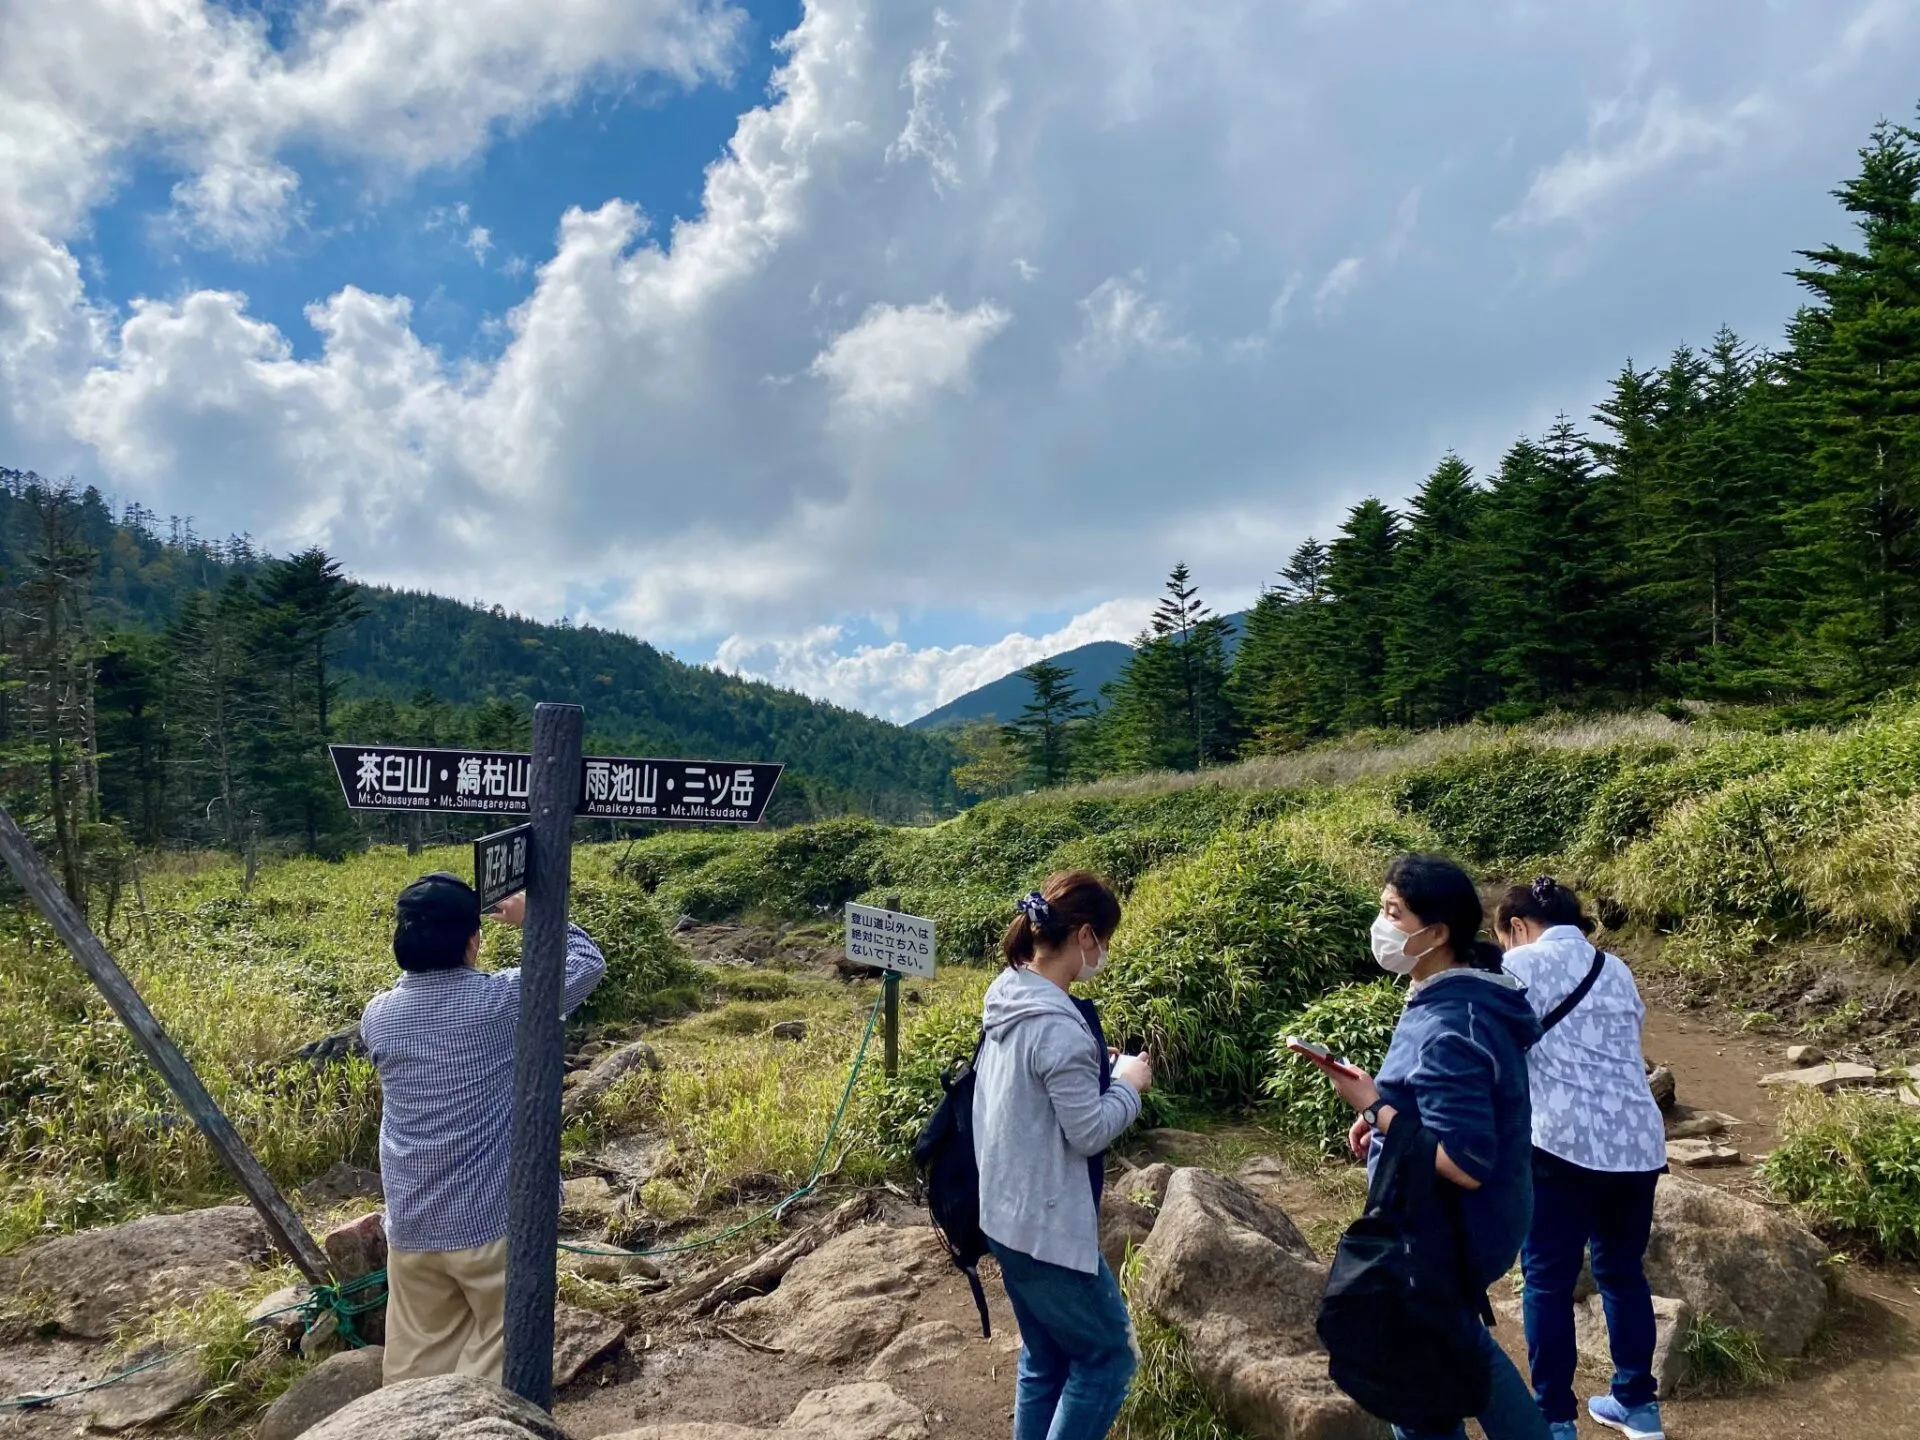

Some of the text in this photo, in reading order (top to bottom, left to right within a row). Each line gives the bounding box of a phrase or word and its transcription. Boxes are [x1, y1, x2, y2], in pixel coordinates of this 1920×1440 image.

[588, 801, 657, 815] Amaikeyama
[851, 912, 929, 940] 登山道以外へは
[851, 928, 929, 955] 絶対に立ち入ら
[851, 943, 923, 970] ないで下さい。
